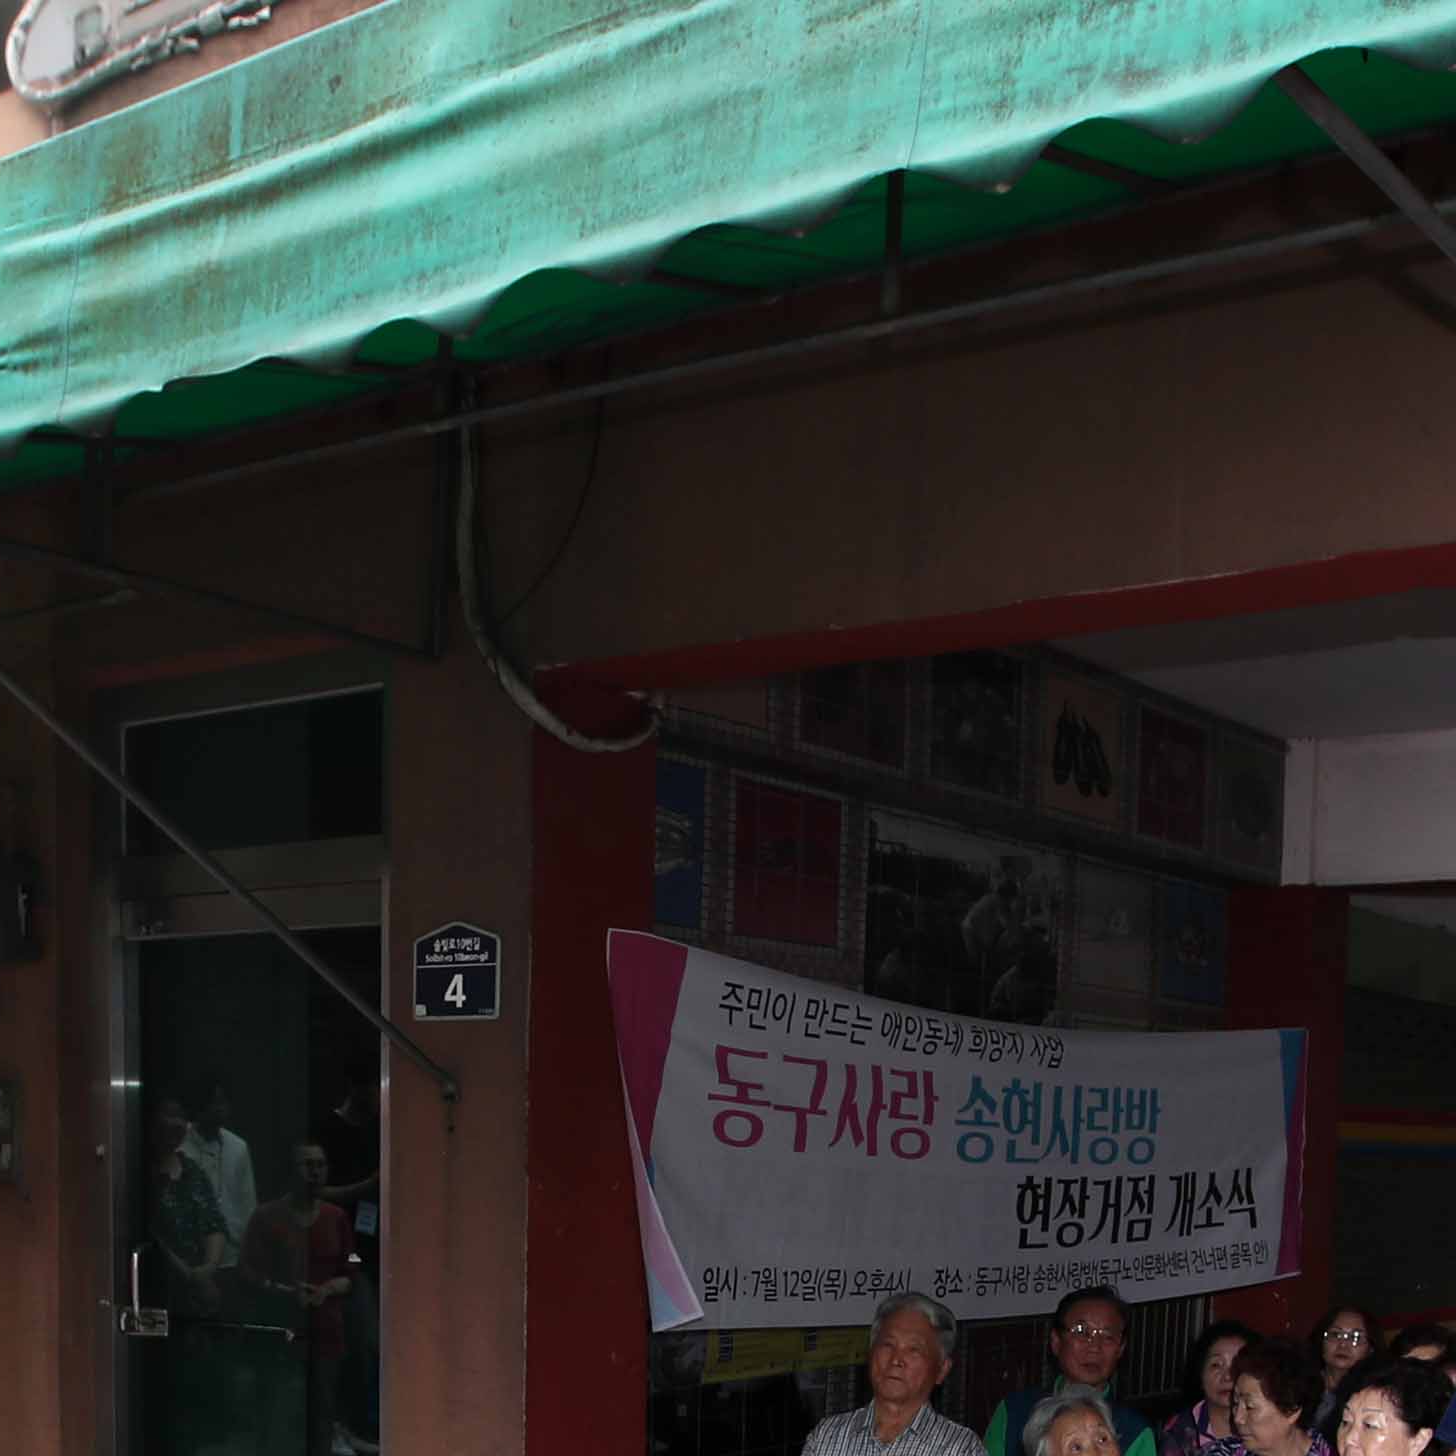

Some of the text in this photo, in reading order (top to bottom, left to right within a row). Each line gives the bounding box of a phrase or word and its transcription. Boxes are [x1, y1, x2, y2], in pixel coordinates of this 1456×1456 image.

[444, 974, 466, 1008] 4
[719, 981, 1065, 1069] 주민이 만드는 애인동네 희망지 사업
[707, 1044, 1162, 1166] 동구사랑 송현사랑방
[1016, 1167, 1257, 1250] 현장거점 개소식
[751, 1266, 778, 1301] 7월
[783, 1266, 847, 1302] 12일(목)
[976, 1266, 1031, 1297] 동구사랑
[1191, 1248, 1229, 1274] 건너편
[1231, 1243, 1253, 1268] 골목
